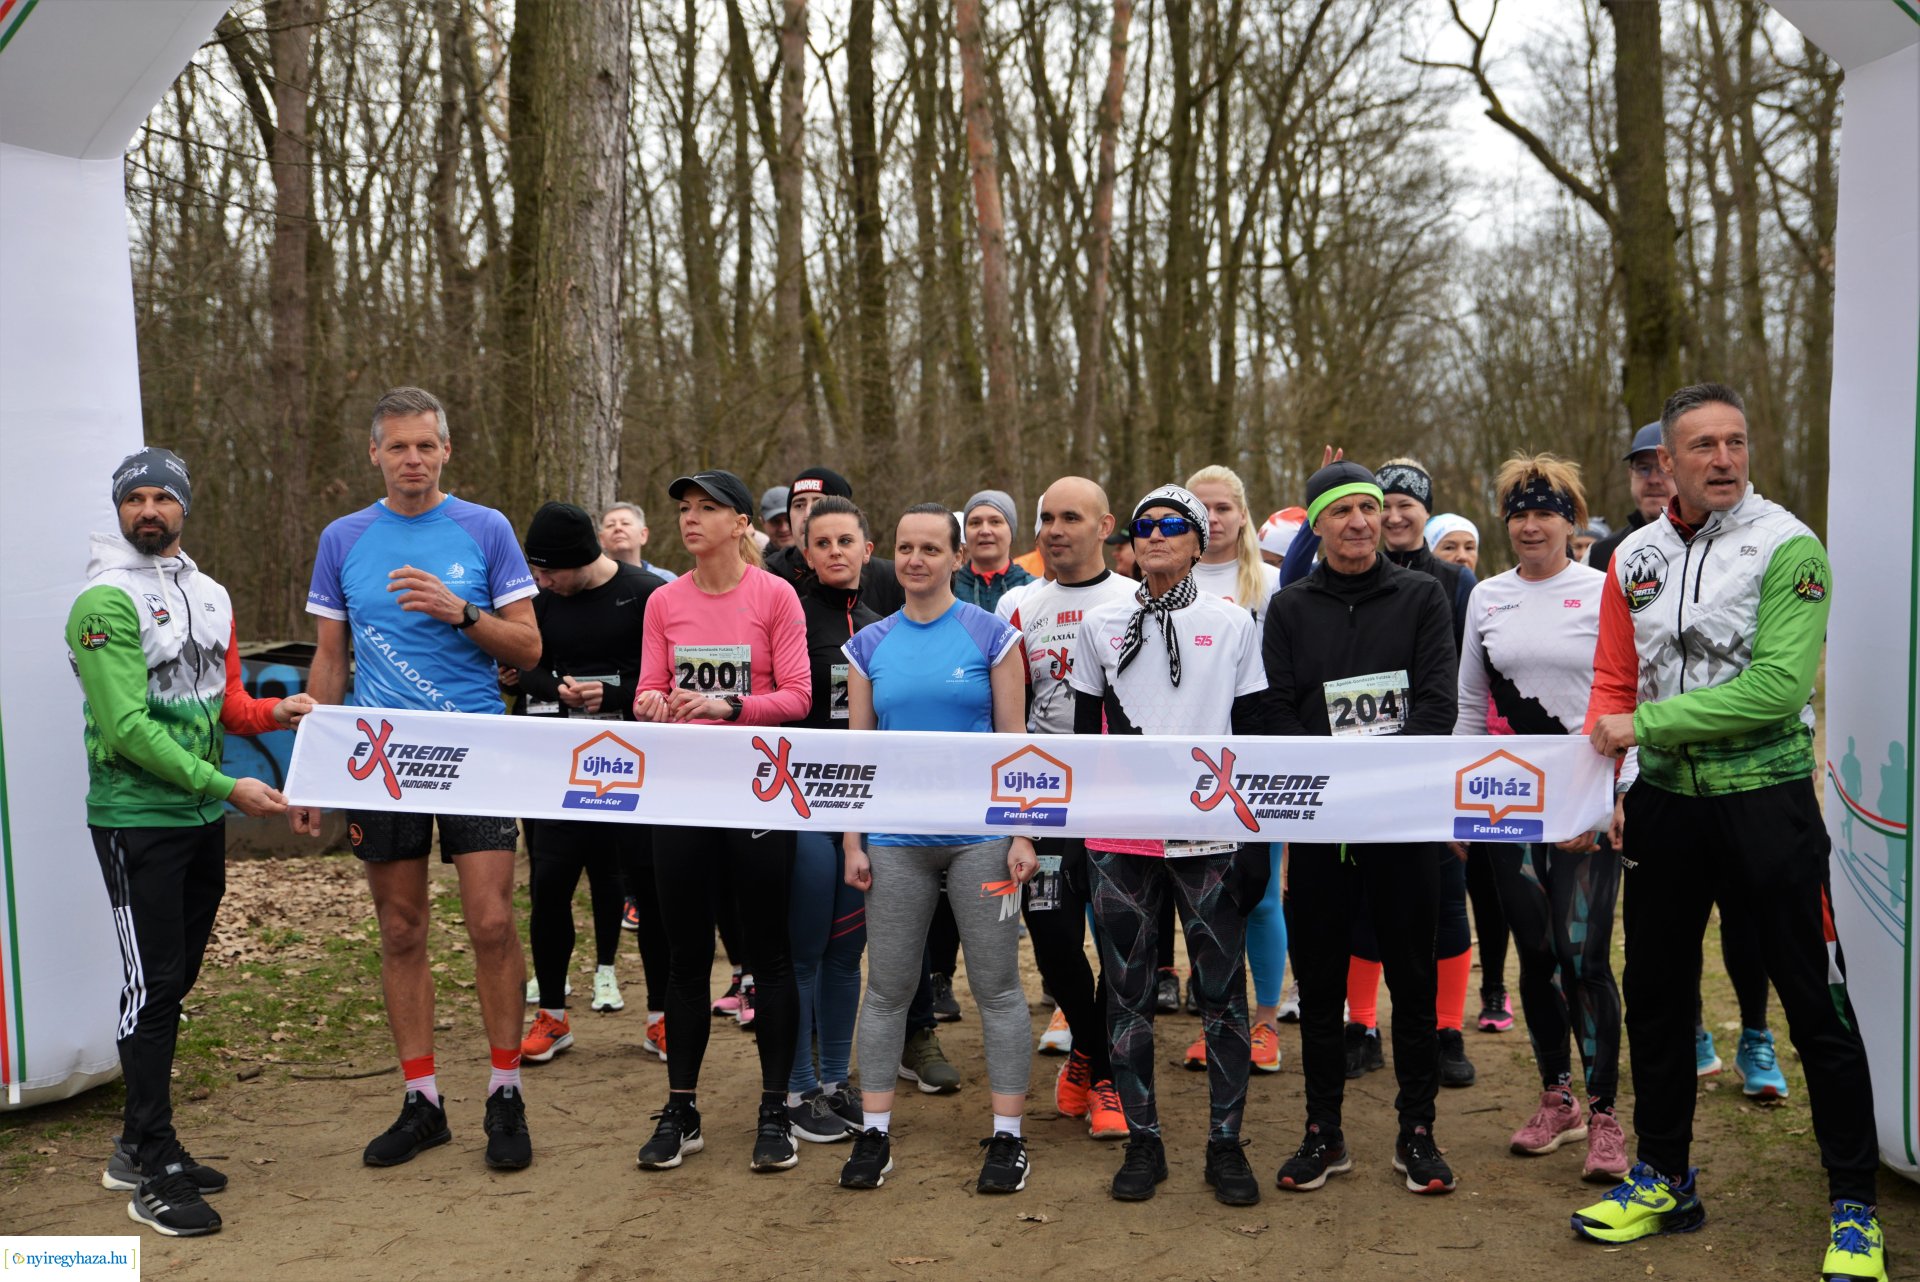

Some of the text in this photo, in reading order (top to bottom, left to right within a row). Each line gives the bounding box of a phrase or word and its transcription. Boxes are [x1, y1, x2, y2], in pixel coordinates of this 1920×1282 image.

[793, 480, 821, 492] MARVEL
[1564, 599, 1582, 609] 575
[1051, 632, 1077, 642] AXIÁL
[1194, 635, 1214, 647] 575
[364, 624, 445, 702] SZALADÓK
[678, 662, 737, 690] 200
[1332, 689, 1399, 728] 204
[347, 718, 470, 800] EXTREME
[396, 761, 460, 779] TRAIL
[751, 735, 878, 820] EXTREME
[400, 779, 453, 791] HUNGARY SE
[804, 781, 874, 799] TRAIL
[1190, 746, 1331, 833] EXTREME
[579, 796, 622, 806] Farm-Ker
[809, 800, 865, 810] HUNGARY SE
[1247, 791, 1324, 807] TRAIL
[1003, 811, 1049, 820] Farm-Ker
[1255, 808, 1316, 820] HUNGARY SE
[1473, 824, 1524, 835] Farm-Ker
